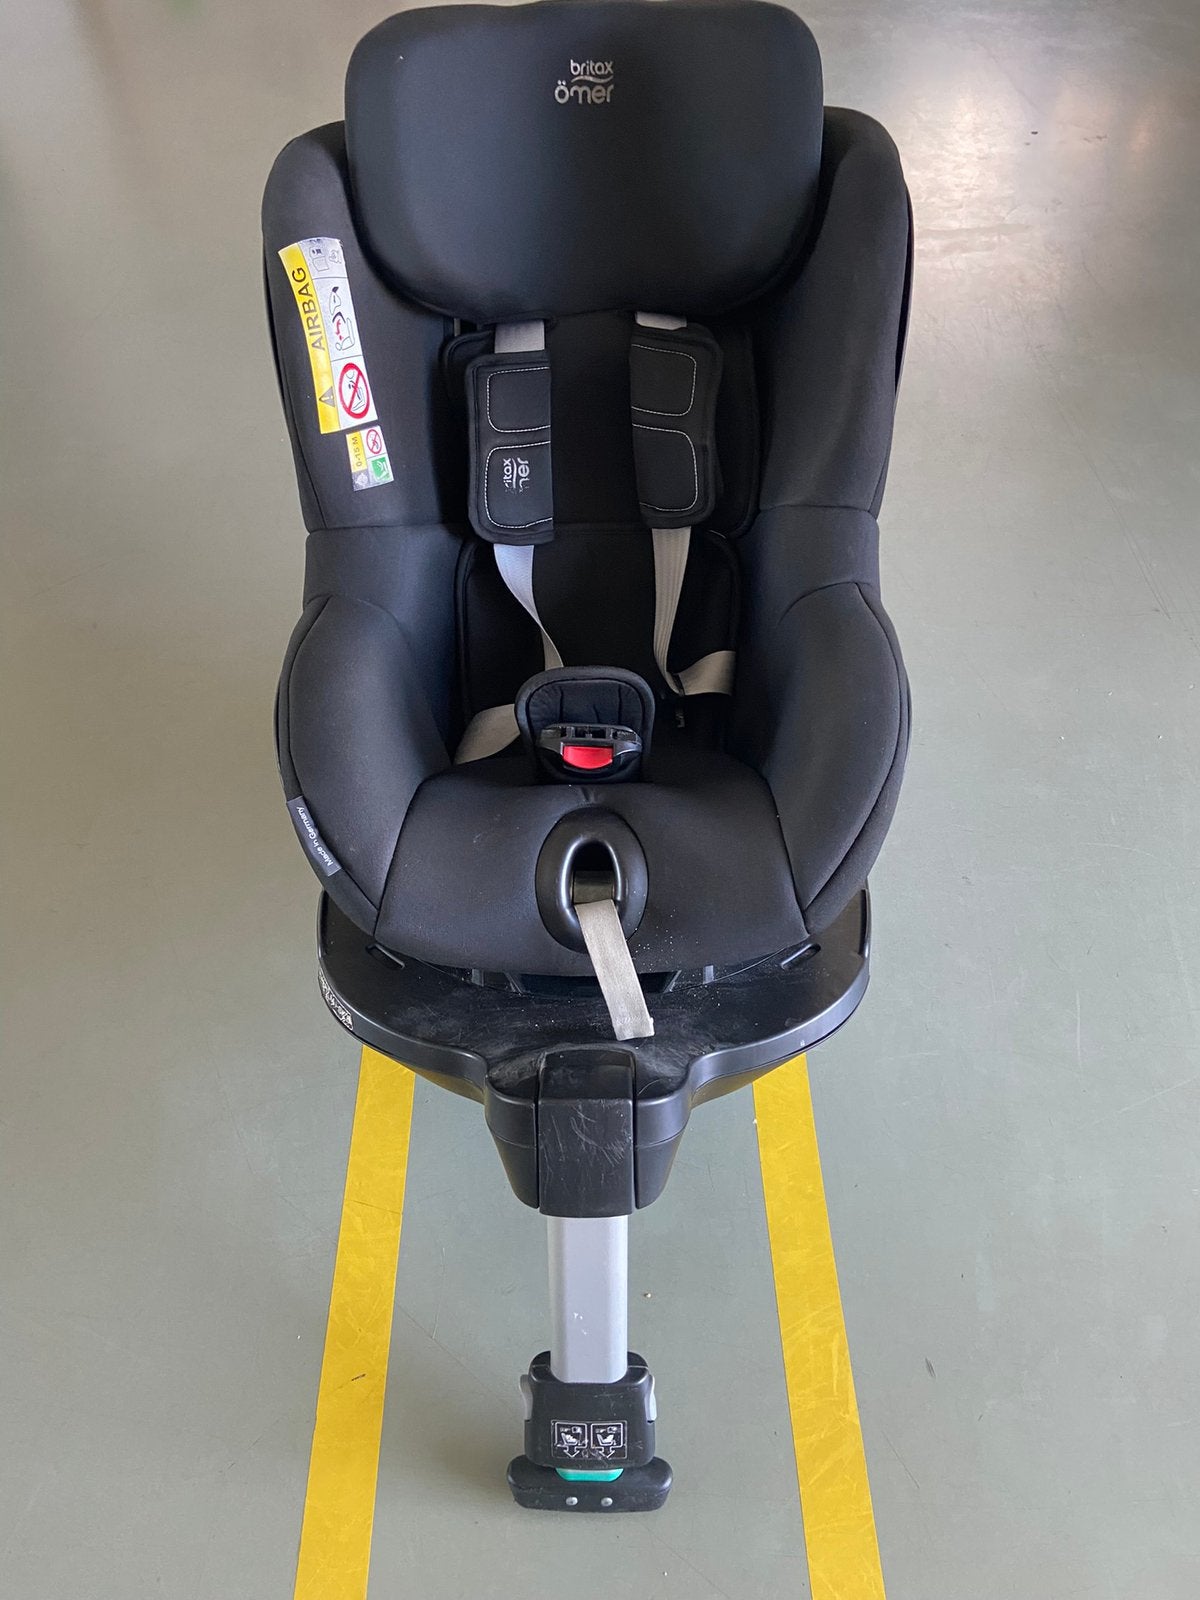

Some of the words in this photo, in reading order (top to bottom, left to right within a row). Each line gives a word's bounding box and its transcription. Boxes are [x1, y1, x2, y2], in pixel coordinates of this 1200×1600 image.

[570, 59, 614, 75] britax
[554, 80, 614, 104] ömer
[292, 267, 325, 351] AIRBAG
[296, 806, 317, 840] Germany
[313, 839, 320, 848] in
[317, 846, 334, 867] Made
